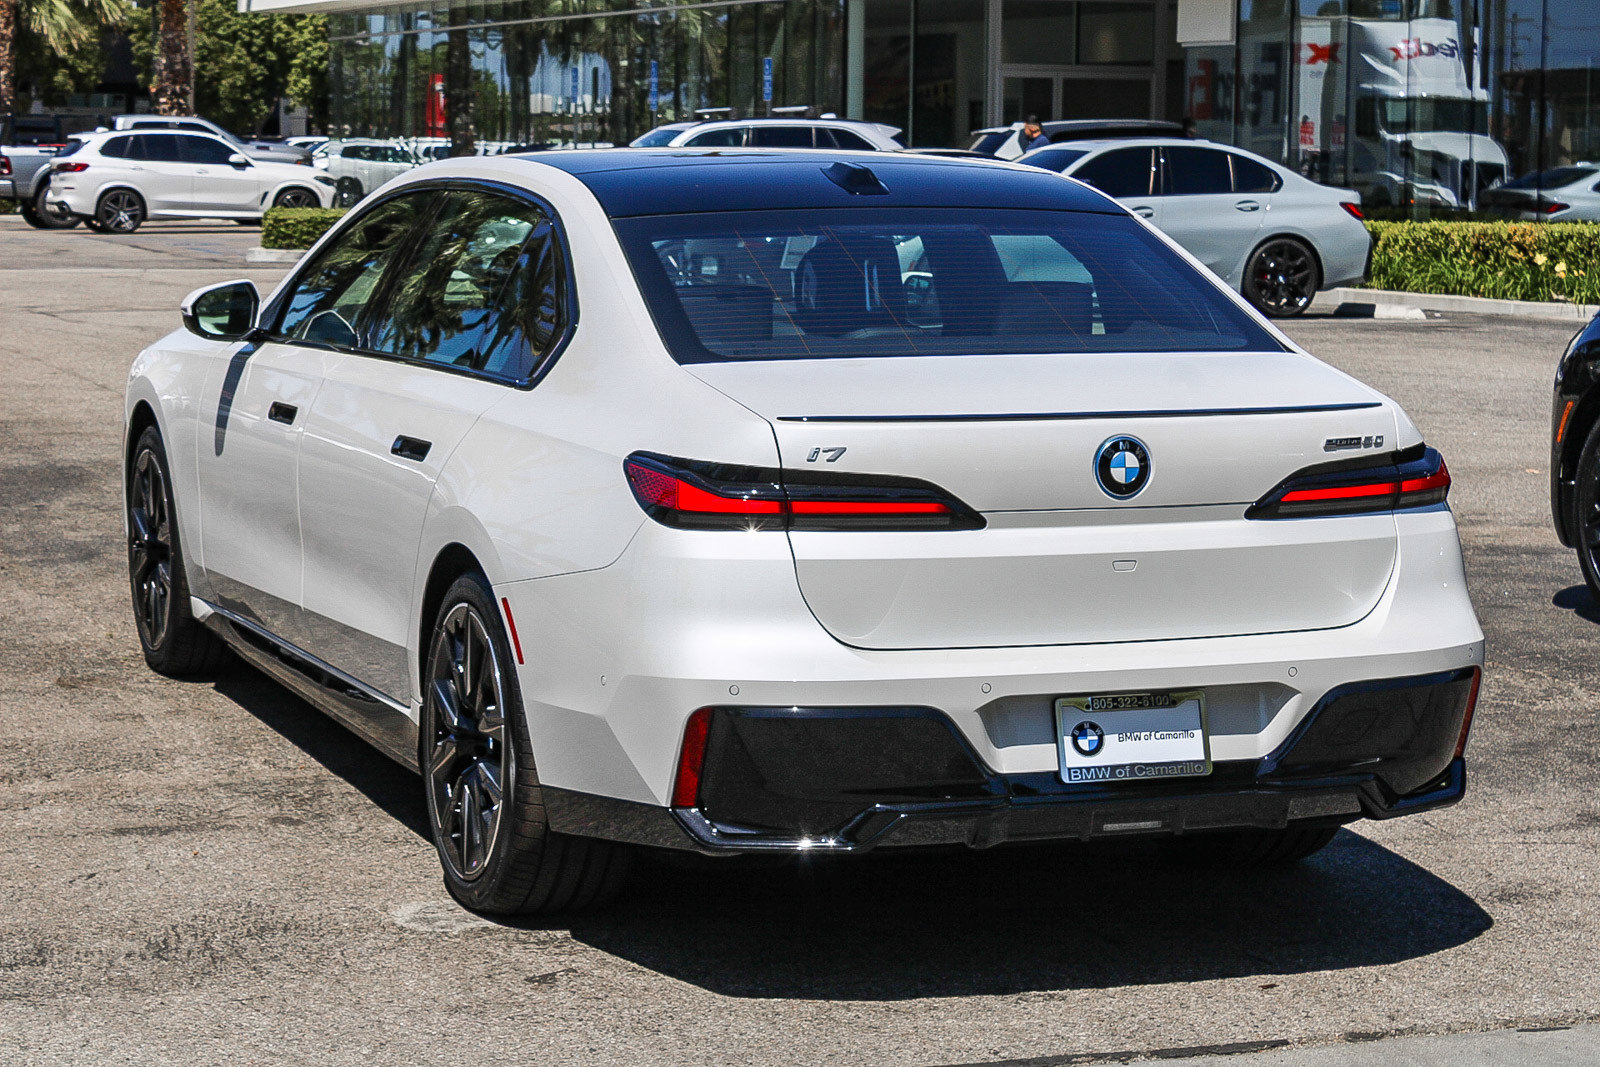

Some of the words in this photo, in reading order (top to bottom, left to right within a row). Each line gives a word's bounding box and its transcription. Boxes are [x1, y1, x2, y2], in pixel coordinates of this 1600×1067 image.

[806, 447, 847, 462] i7
[1092, 695, 1170, 710] 805-322-6100
[1118, 733, 1142, 743] BMW
[1143, 732, 1152, 741] of
[1153, 730, 1195, 741] Camarillo
[1070, 767, 1111, 781] BMW
[1116, 766, 1131, 778] of
[1134, 762, 1204, 776] Camarillo
